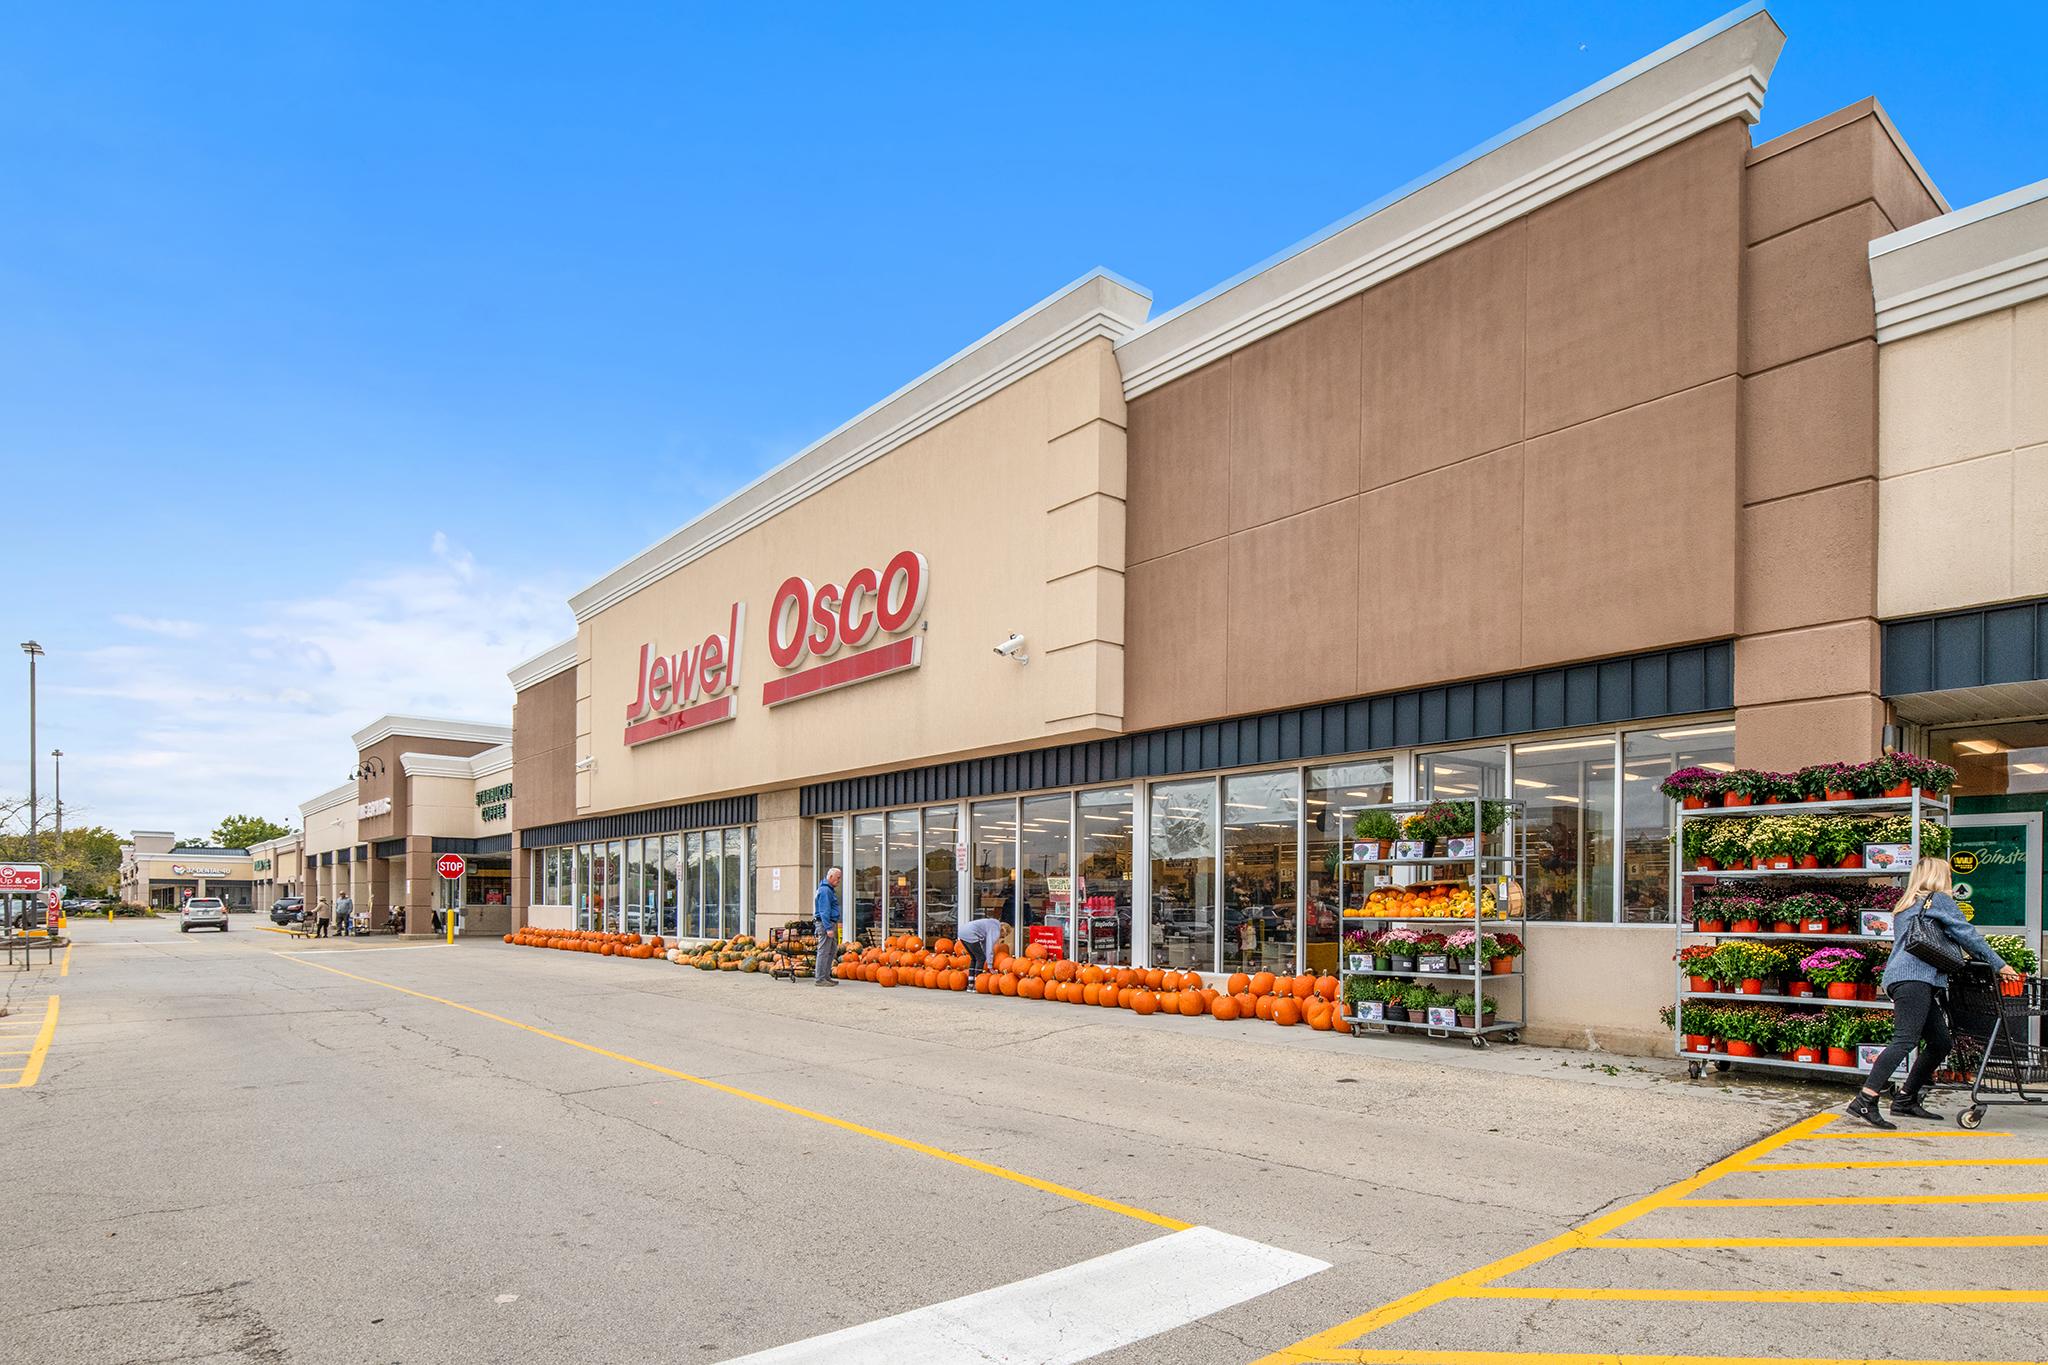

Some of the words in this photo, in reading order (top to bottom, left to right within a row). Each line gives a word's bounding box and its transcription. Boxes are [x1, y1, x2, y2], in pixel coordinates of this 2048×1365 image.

[626, 602, 746, 721] Jewel
[768, 550, 928, 669] Osco
[476, 783, 513, 806] STARBUCKS
[482, 803, 507, 822] COFFEE
[1975, 847, 2027, 865] Coinsta
[439, 861, 463, 872] STOP
[0, 877, 13, 886] Up
